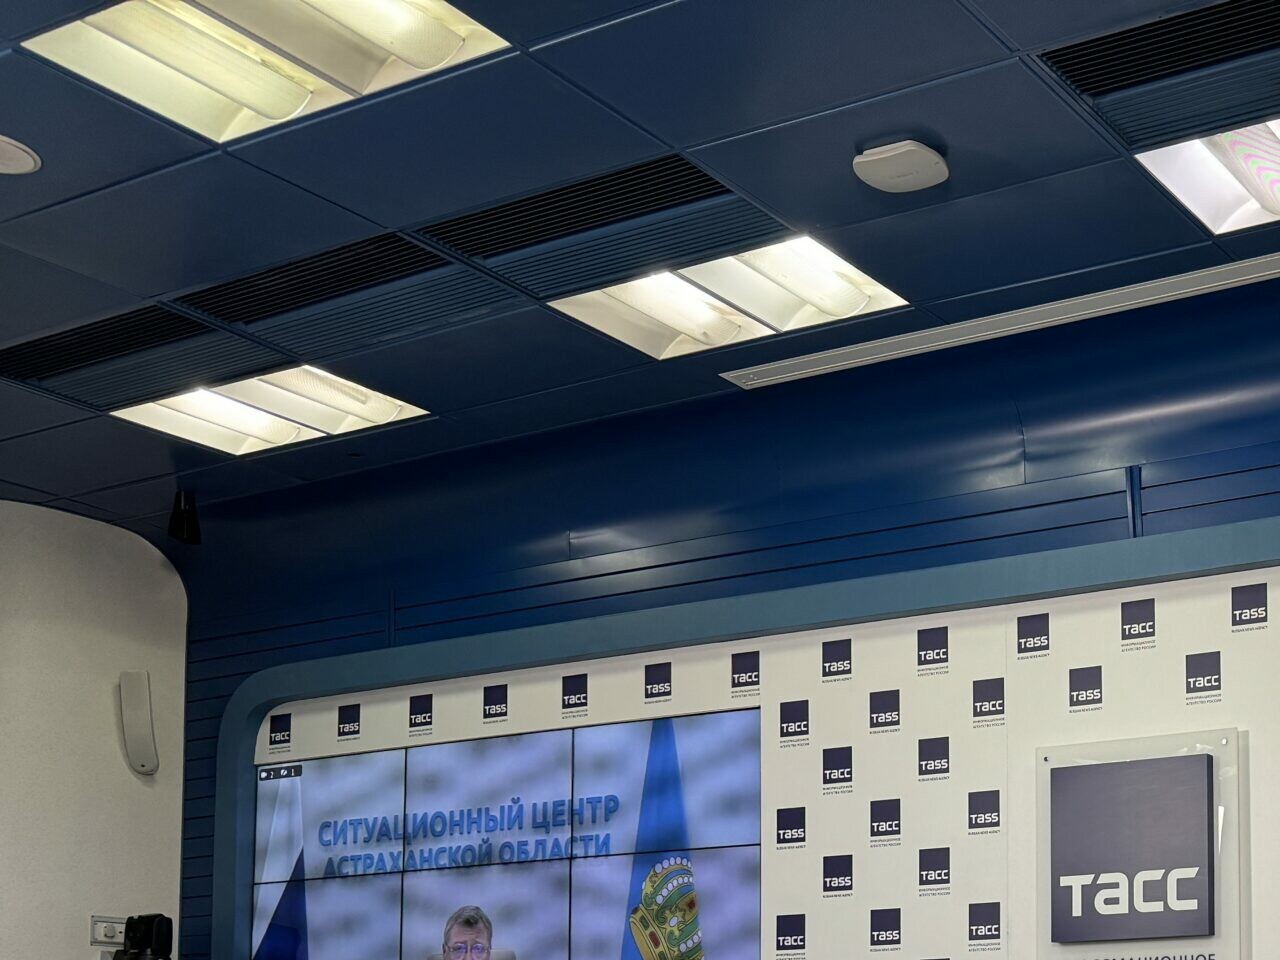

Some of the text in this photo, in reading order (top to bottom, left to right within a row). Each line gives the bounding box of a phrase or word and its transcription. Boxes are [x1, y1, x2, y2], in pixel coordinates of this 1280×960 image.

[318, 794, 620, 846] СИТУАЦИОННЫЙ ЦЕНТР
[323, 833, 611, 877] АСТРАХАНСКОЙ ОБЛАСТИ
